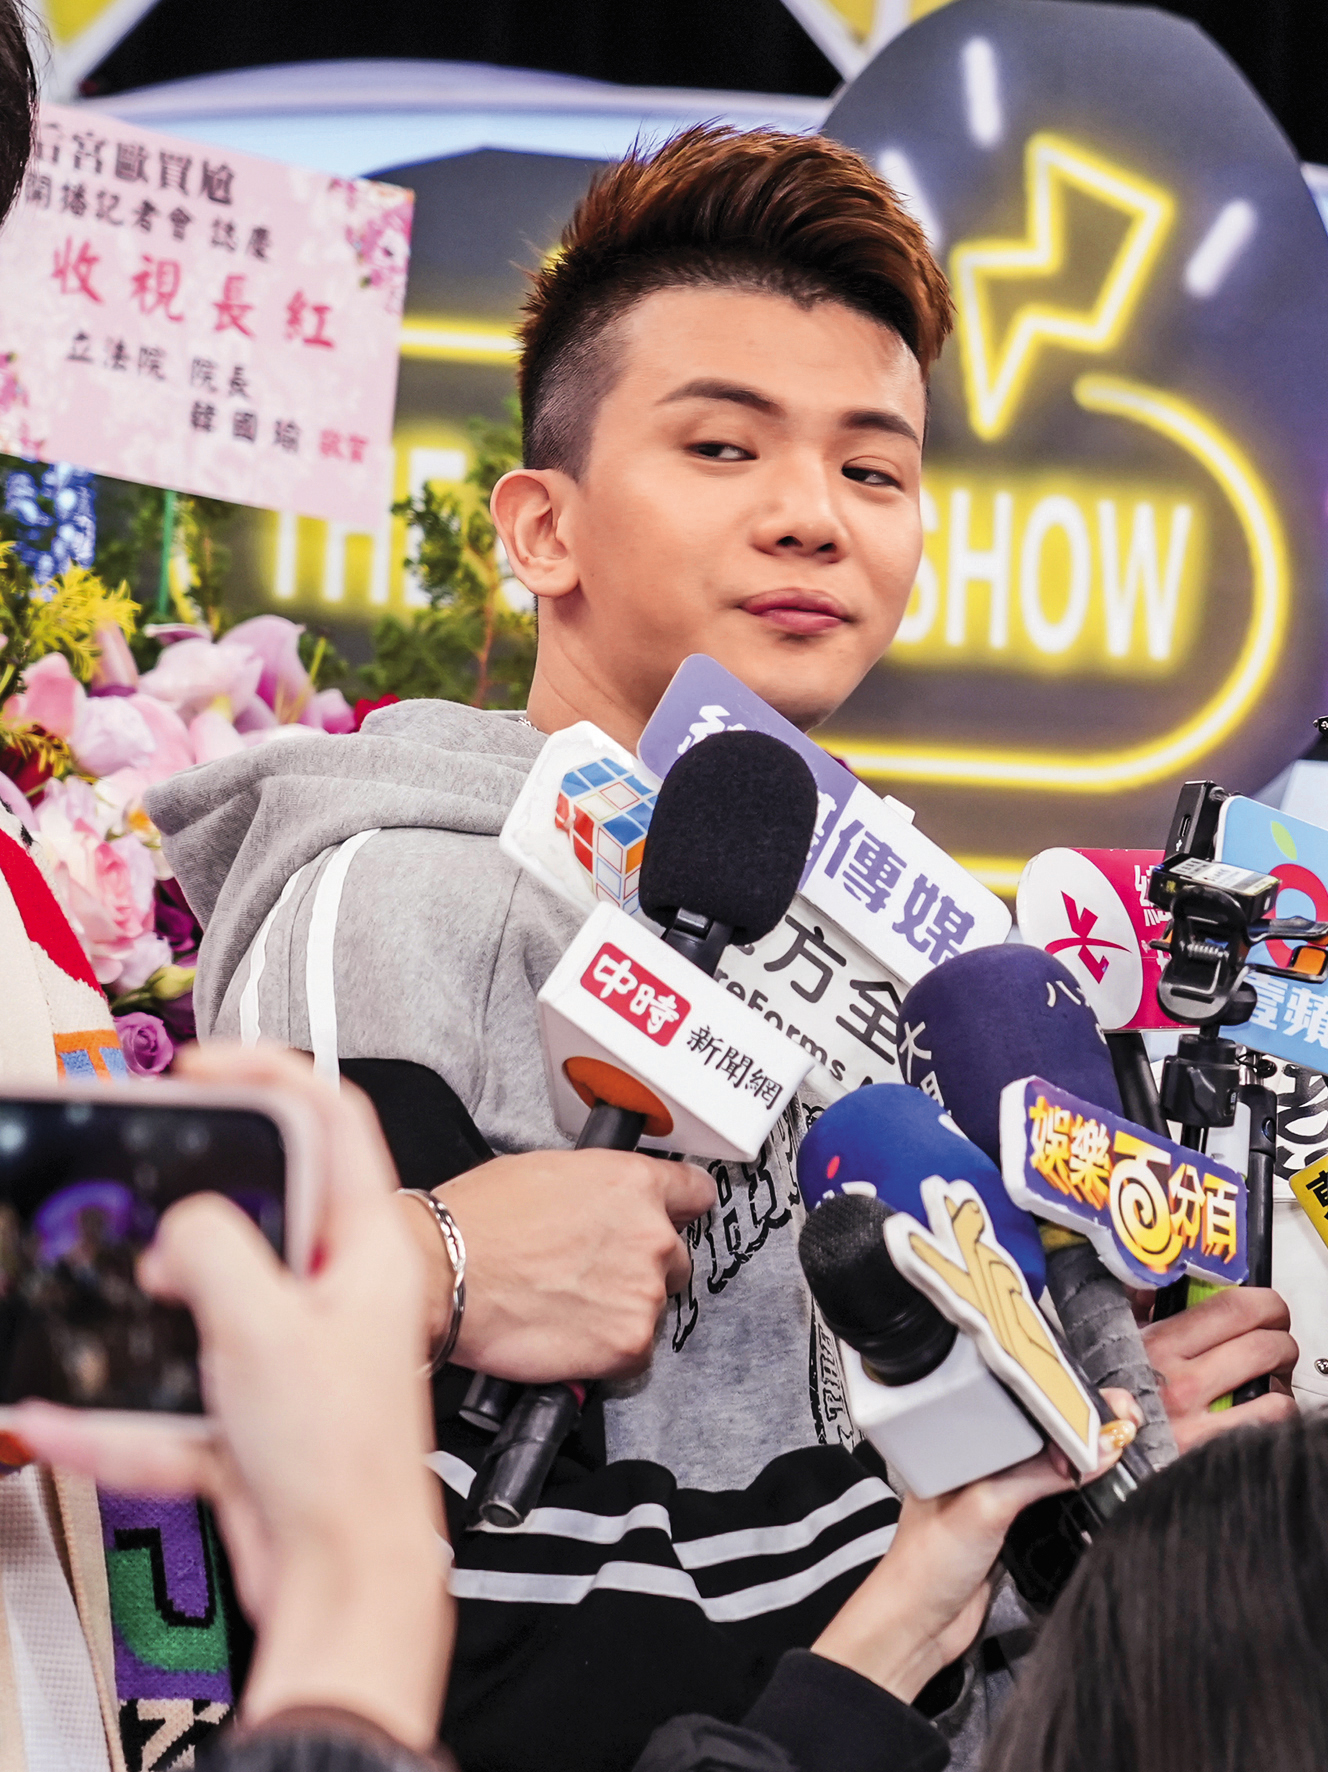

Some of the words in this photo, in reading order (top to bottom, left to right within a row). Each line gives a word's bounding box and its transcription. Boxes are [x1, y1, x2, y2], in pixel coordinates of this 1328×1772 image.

[52, 234, 334, 351] 收視長紅
[66, 330, 167, 382] 立法院
[190, 355, 251, 401] 院長
